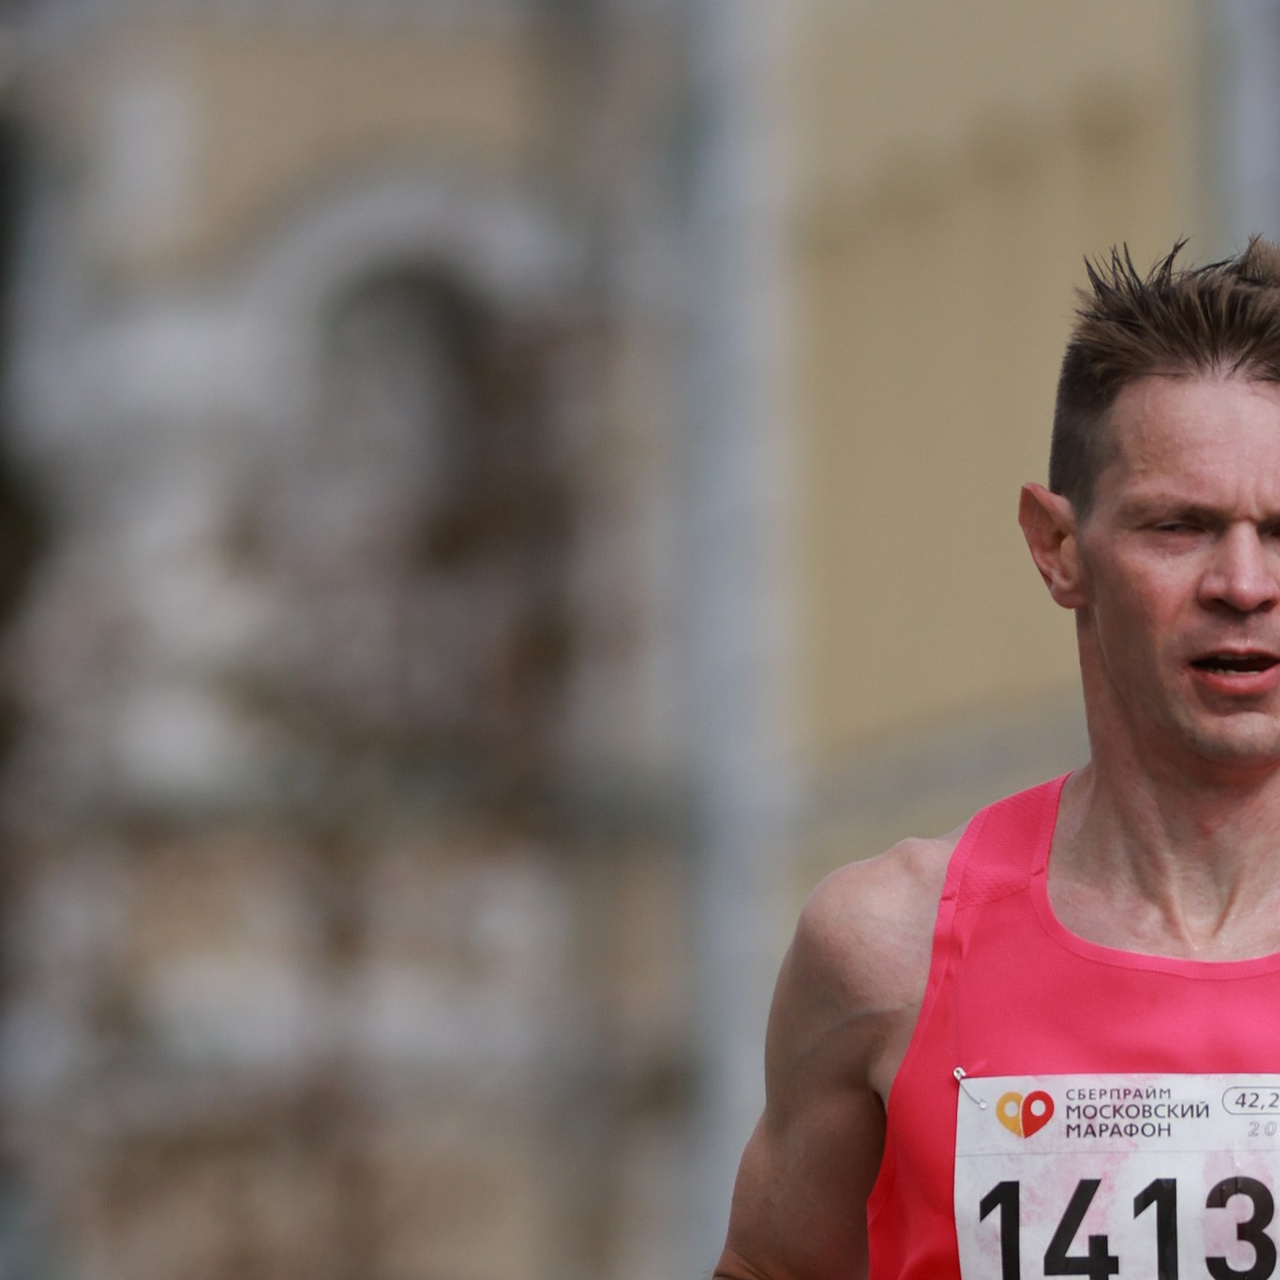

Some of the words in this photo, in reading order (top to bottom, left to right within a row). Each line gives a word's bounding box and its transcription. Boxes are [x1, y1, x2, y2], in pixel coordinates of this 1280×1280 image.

[1066, 1086, 1171, 1100] СБЕРПРАЙМ
[1235, 1092, 1279, 1110] 42,2
[1066, 1101, 1210, 1119] МОСКОВСКИЙ
[1066, 1123, 1171, 1138] МАРАФОН
